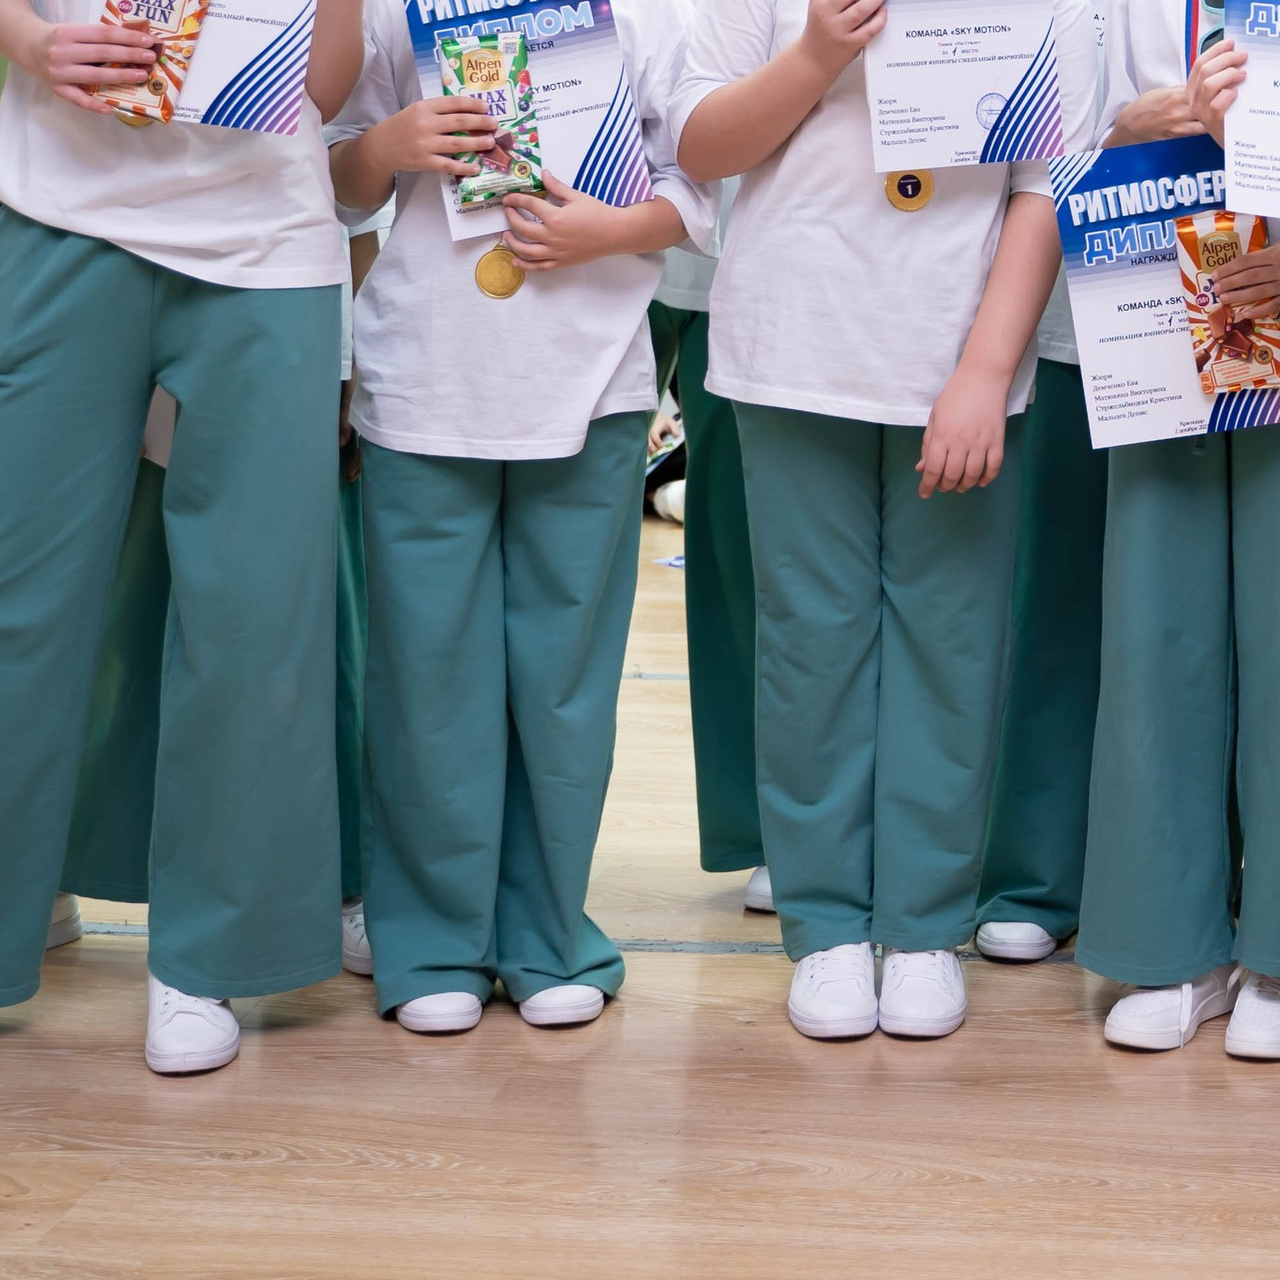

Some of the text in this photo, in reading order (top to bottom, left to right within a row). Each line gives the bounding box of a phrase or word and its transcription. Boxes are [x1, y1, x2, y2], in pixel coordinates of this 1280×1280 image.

[133, 3, 172, 24] FUN
[906, 25, 1011, 38] КОМАНДА «SKY MOTION»
[466, 58, 502, 73] Alpen
[469, 70, 500, 83] Gold
[543, 79, 582, 92] MOTION»
[906, 184, 912, 195] 1
[1068, 170, 1225, 226] РИТМОСФЕР
[1083, 220, 1177, 267] ДИПЛ
[1201, 241, 1239, 257] Alpen
[1117, 299, 1163, 312] КОМАНДА
[1099, 333, 1143, 344] НОМИНАЦИЯ
